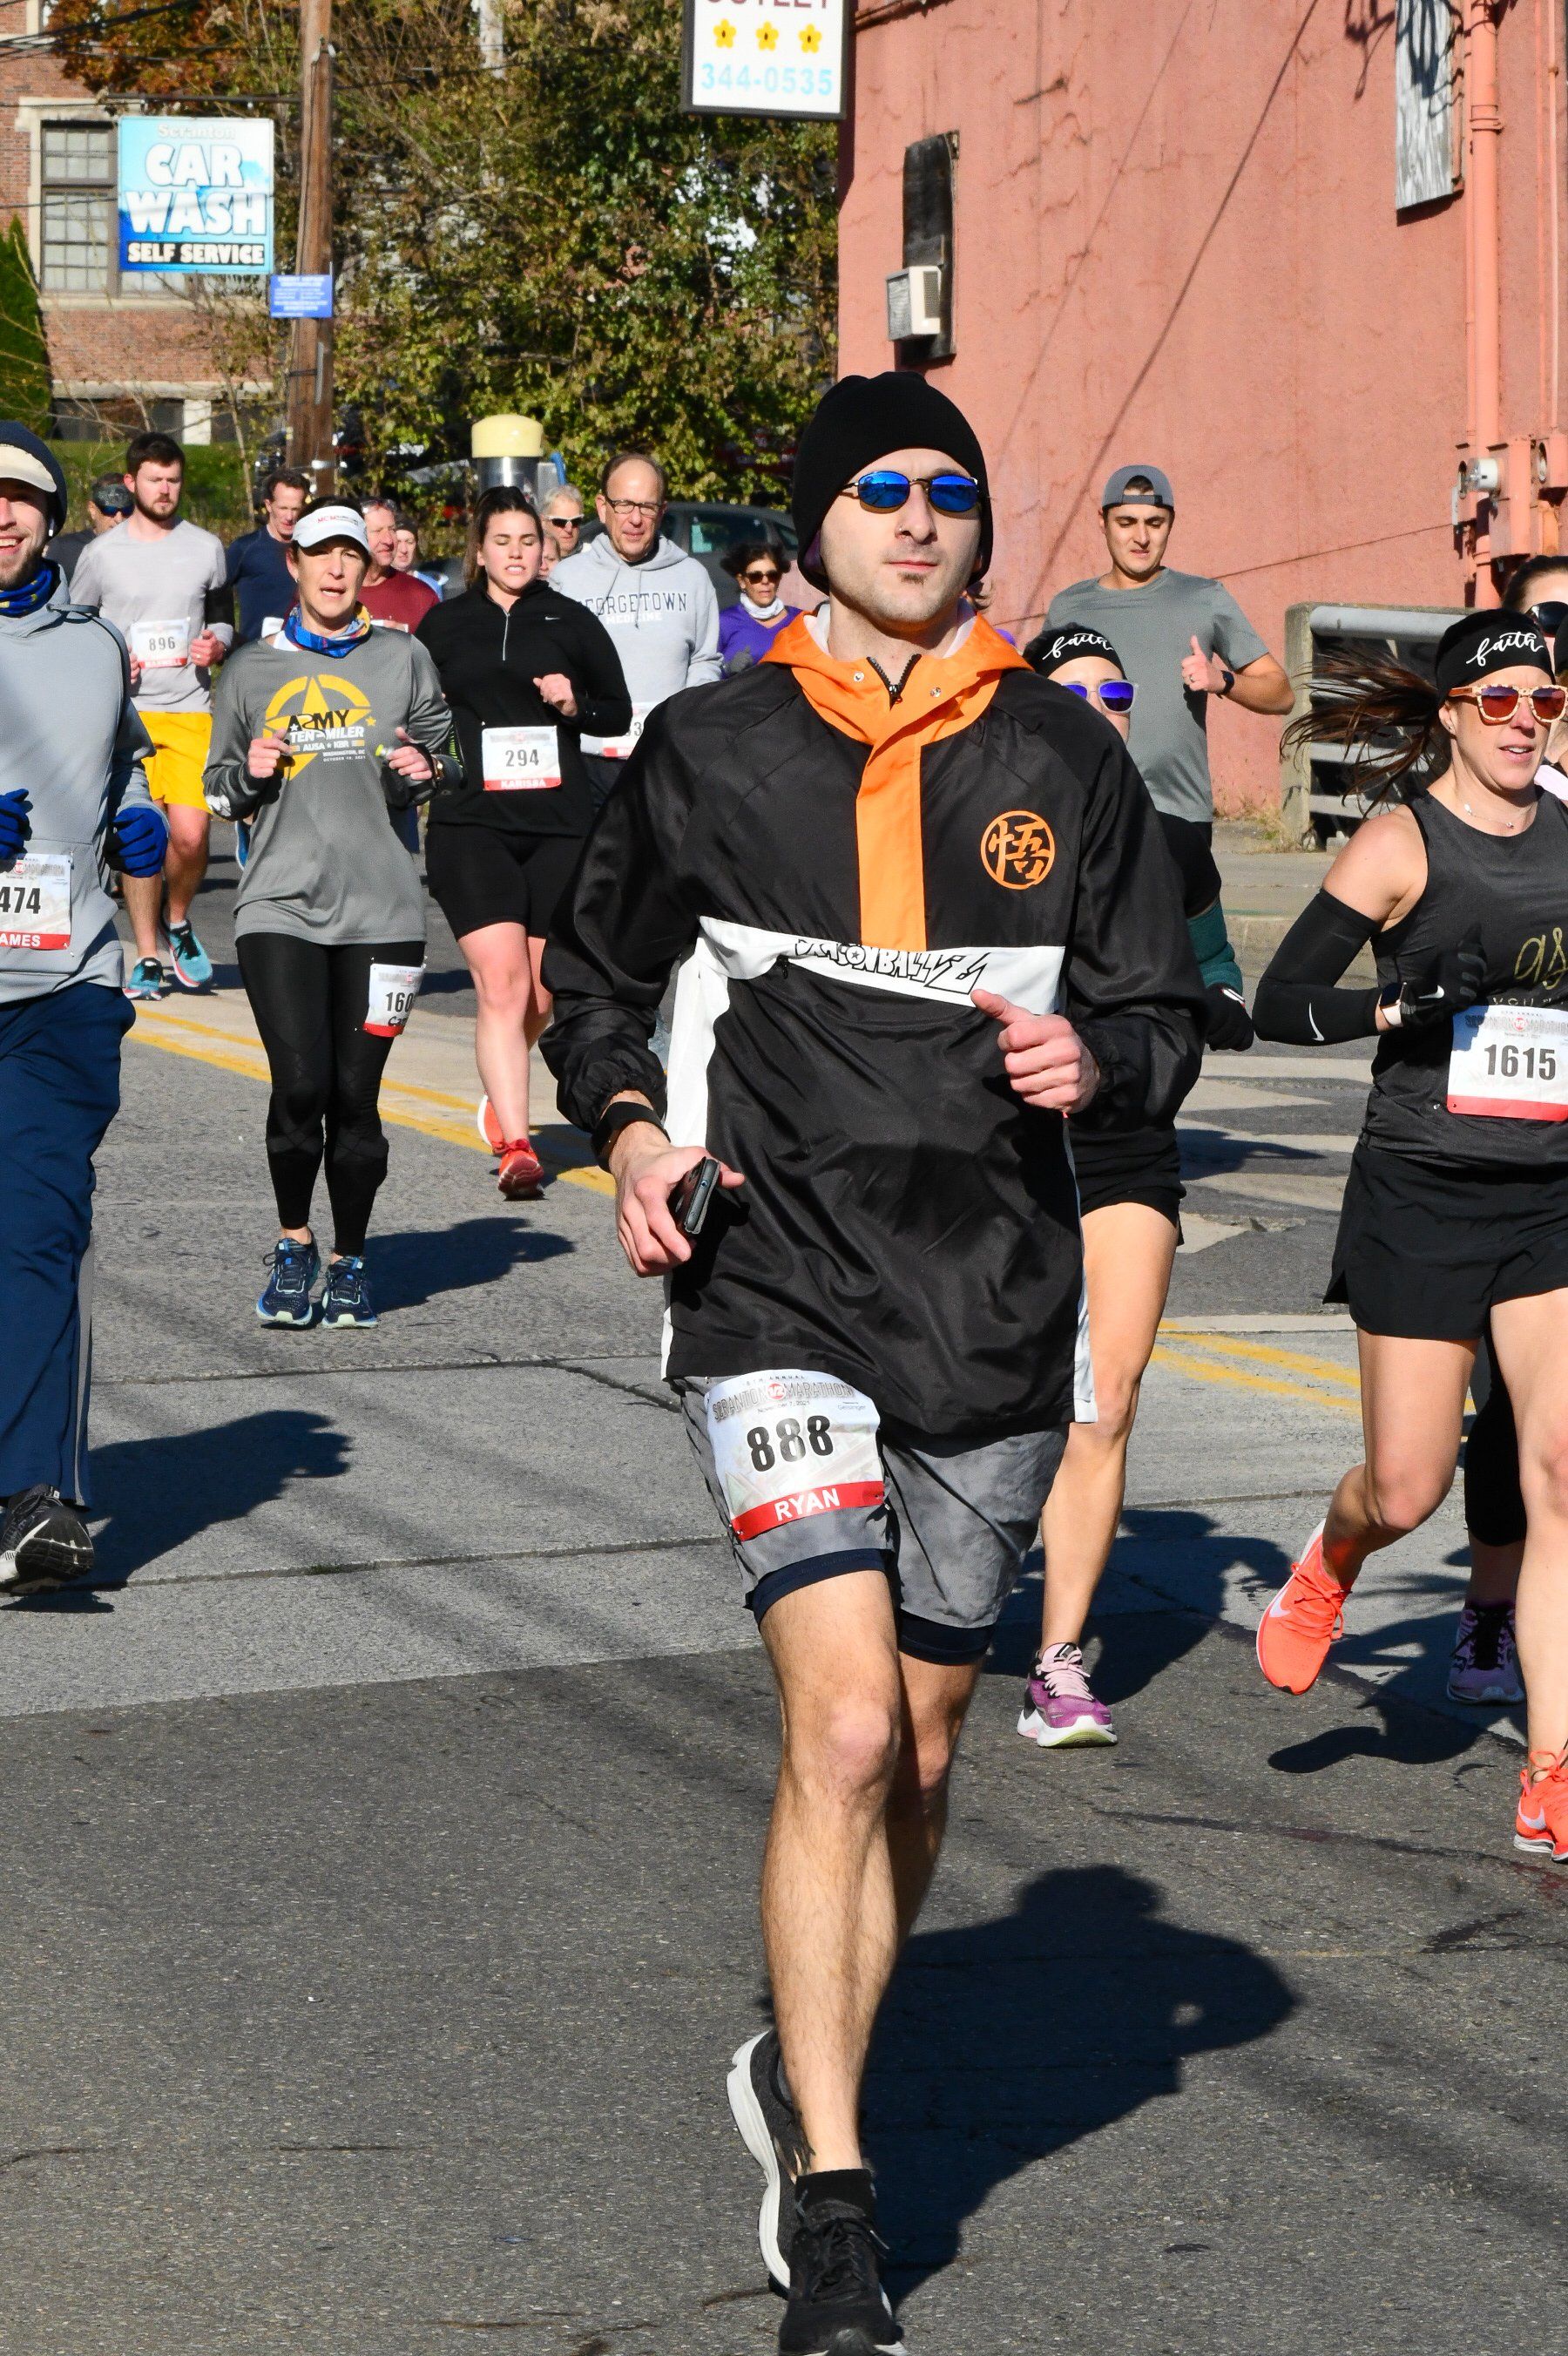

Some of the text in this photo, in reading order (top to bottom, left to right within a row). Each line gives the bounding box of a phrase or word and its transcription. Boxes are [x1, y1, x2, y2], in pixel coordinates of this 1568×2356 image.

[700, 62, 834, 96] 344-0535
[158, 124, 237, 140] Scranton
[145, 143, 245, 188] CAR
[125, 191, 267, 236] WASH
[127, 241, 265, 265] SELF SERVICE
[578, 592, 687, 617] EORGETOWN
[148, 636, 176, 652] 896
[1042, 633, 1114, 660] faith
[1465, 631, 1544, 667] faith
[287, 709, 350, 734] ARMY
[505, 748, 539, 768] 294
[1484, 1044, 1556, 1081] 1615
[712, 1385, 767, 1420] SCRANTON
[784, 1382, 856, 1399] MARATHON
[747, 1415, 834, 1472] 888
[774, 1487, 841, 1522] RYAN
